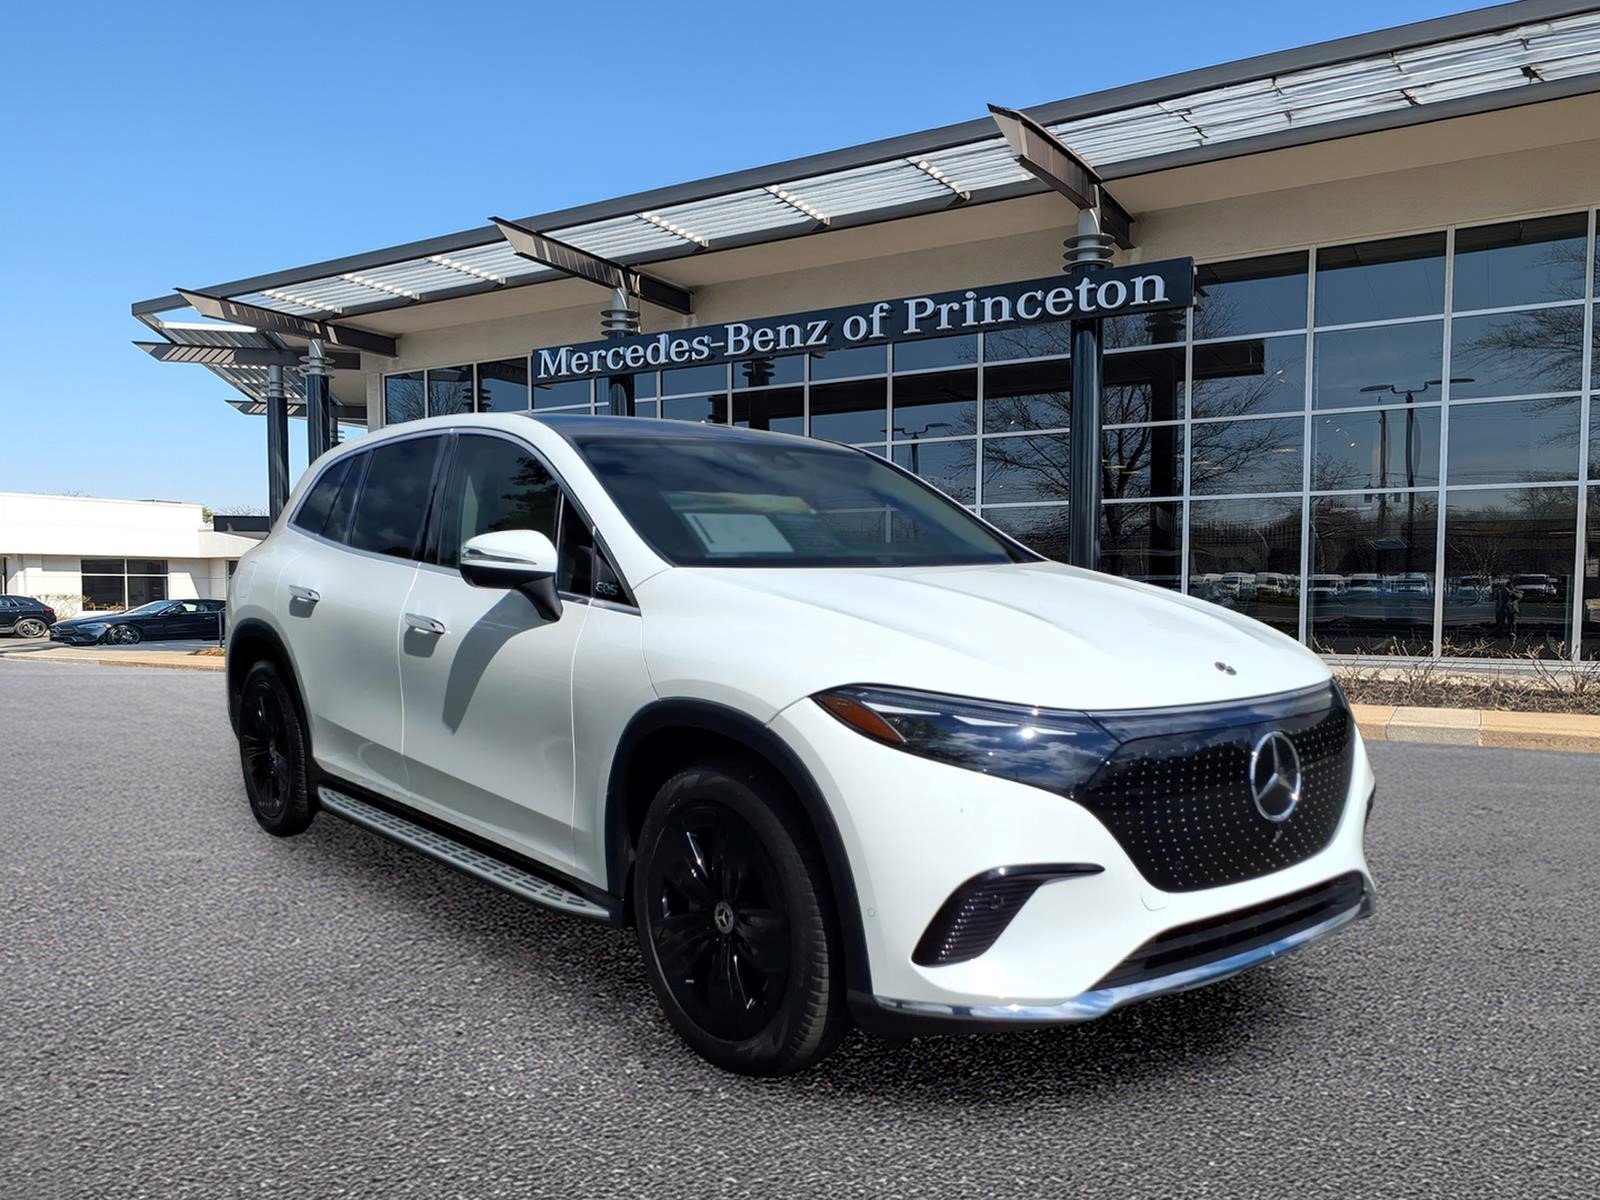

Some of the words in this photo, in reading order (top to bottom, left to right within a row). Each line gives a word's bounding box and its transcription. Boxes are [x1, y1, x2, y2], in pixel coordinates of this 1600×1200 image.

[537, 320, 829, 378] Mercedes-Benz
[843, 302, 891, 341] of
[902, 273, 1168, 334] Princeton
